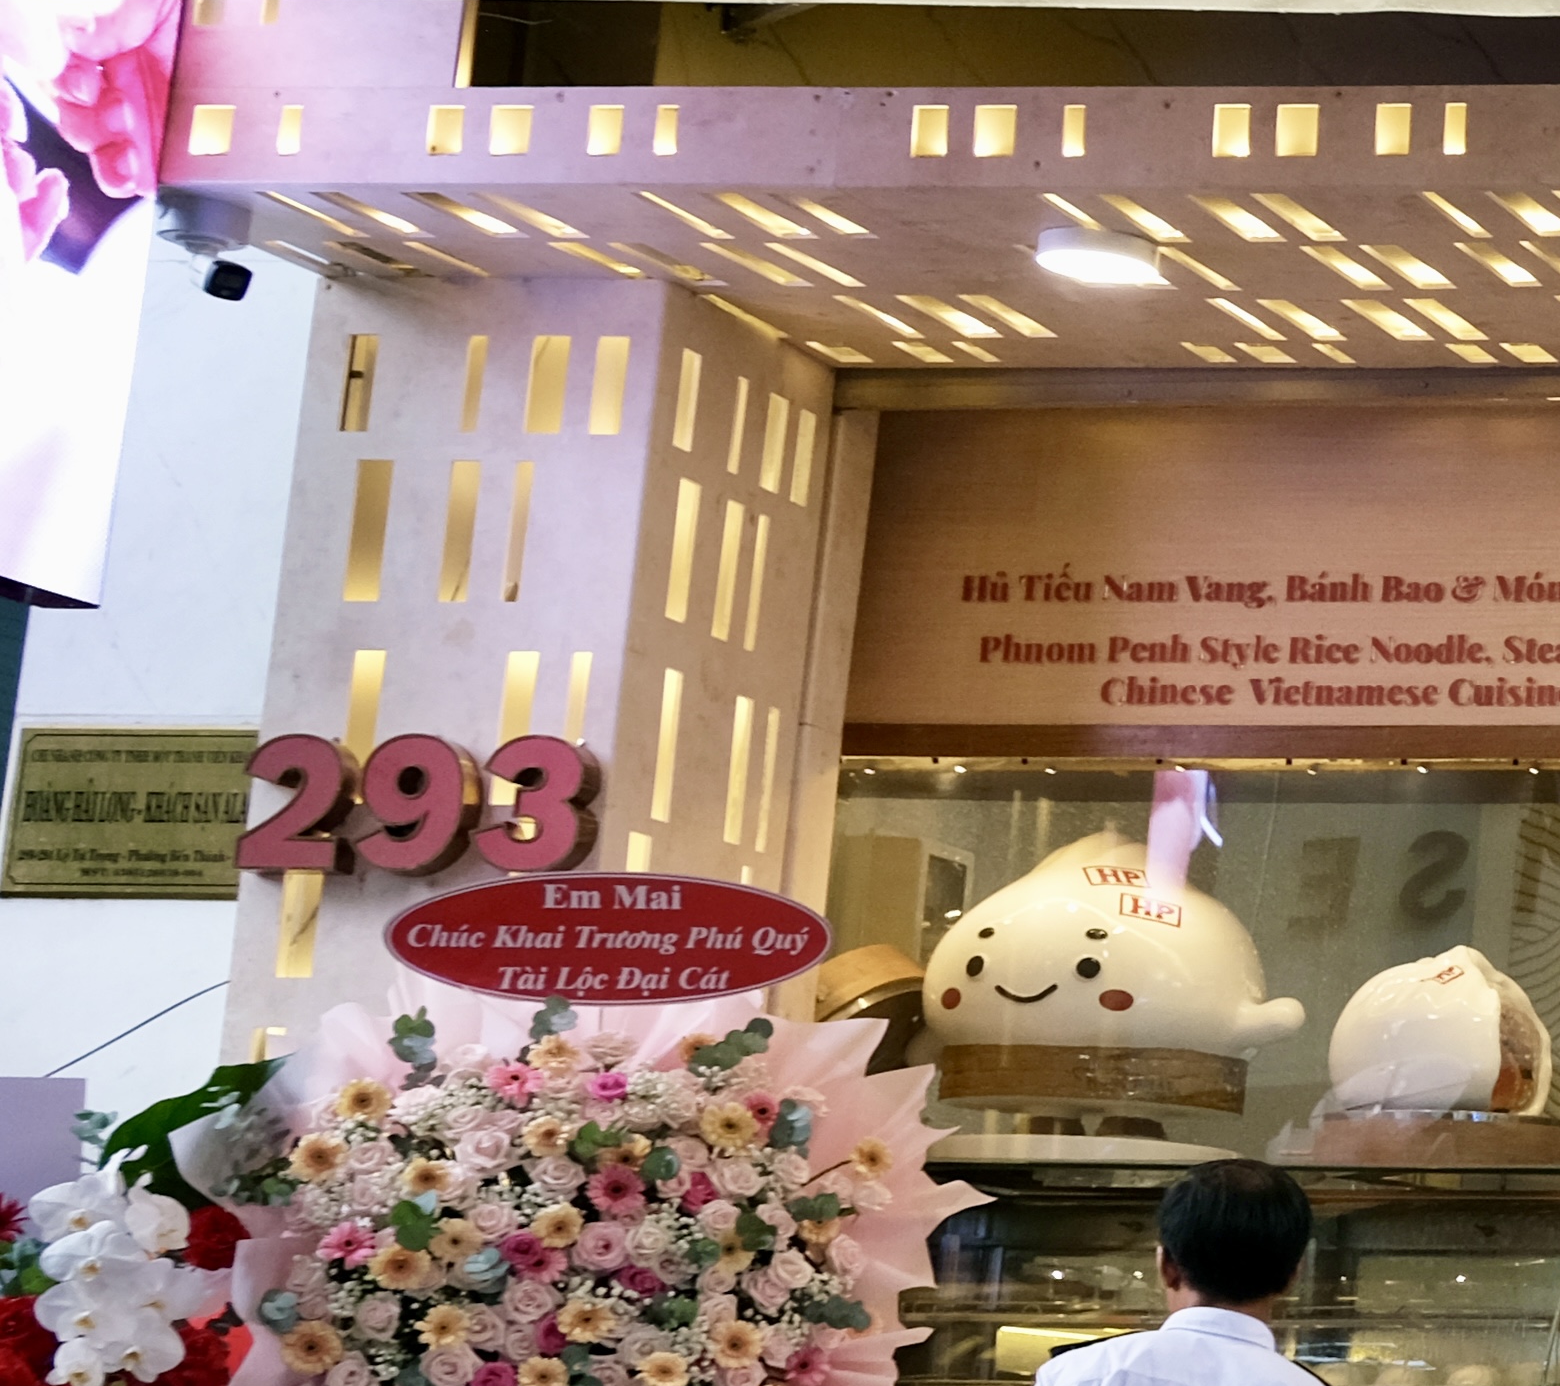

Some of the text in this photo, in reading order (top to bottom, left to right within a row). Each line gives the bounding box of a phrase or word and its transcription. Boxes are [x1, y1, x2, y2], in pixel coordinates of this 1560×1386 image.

[1019, 563, 1093, 603] Tiếu
[1102, 574, 1179, 603] Nam
[1284, 570, 1373, 603] Bánh
[1381, 574, 1446, 603] Bao
[1451, 574, 1486, 603] &
[979, 632, 1097, 665] Phnom
[1106, 632, 1193, 665] Penh
[1199, 633, 1282, 671] Style
[1288, 633, 1362, 665] Rice
[1100, 675, 1236, 708] Chinese
[1248, 675, 1440, 708] Vietnamese
[235, 733, 590, 873] 293
[1096, 869, 1144, 886] HP
[543, 884, 682, 910] Em Mai
[1130, 895, 1176, 919] HP
[407, 923, 809, 956] Chúc Khai Trương Phú Quý
[497, 965, 730, 997] Tài Lộc Đại Cát
